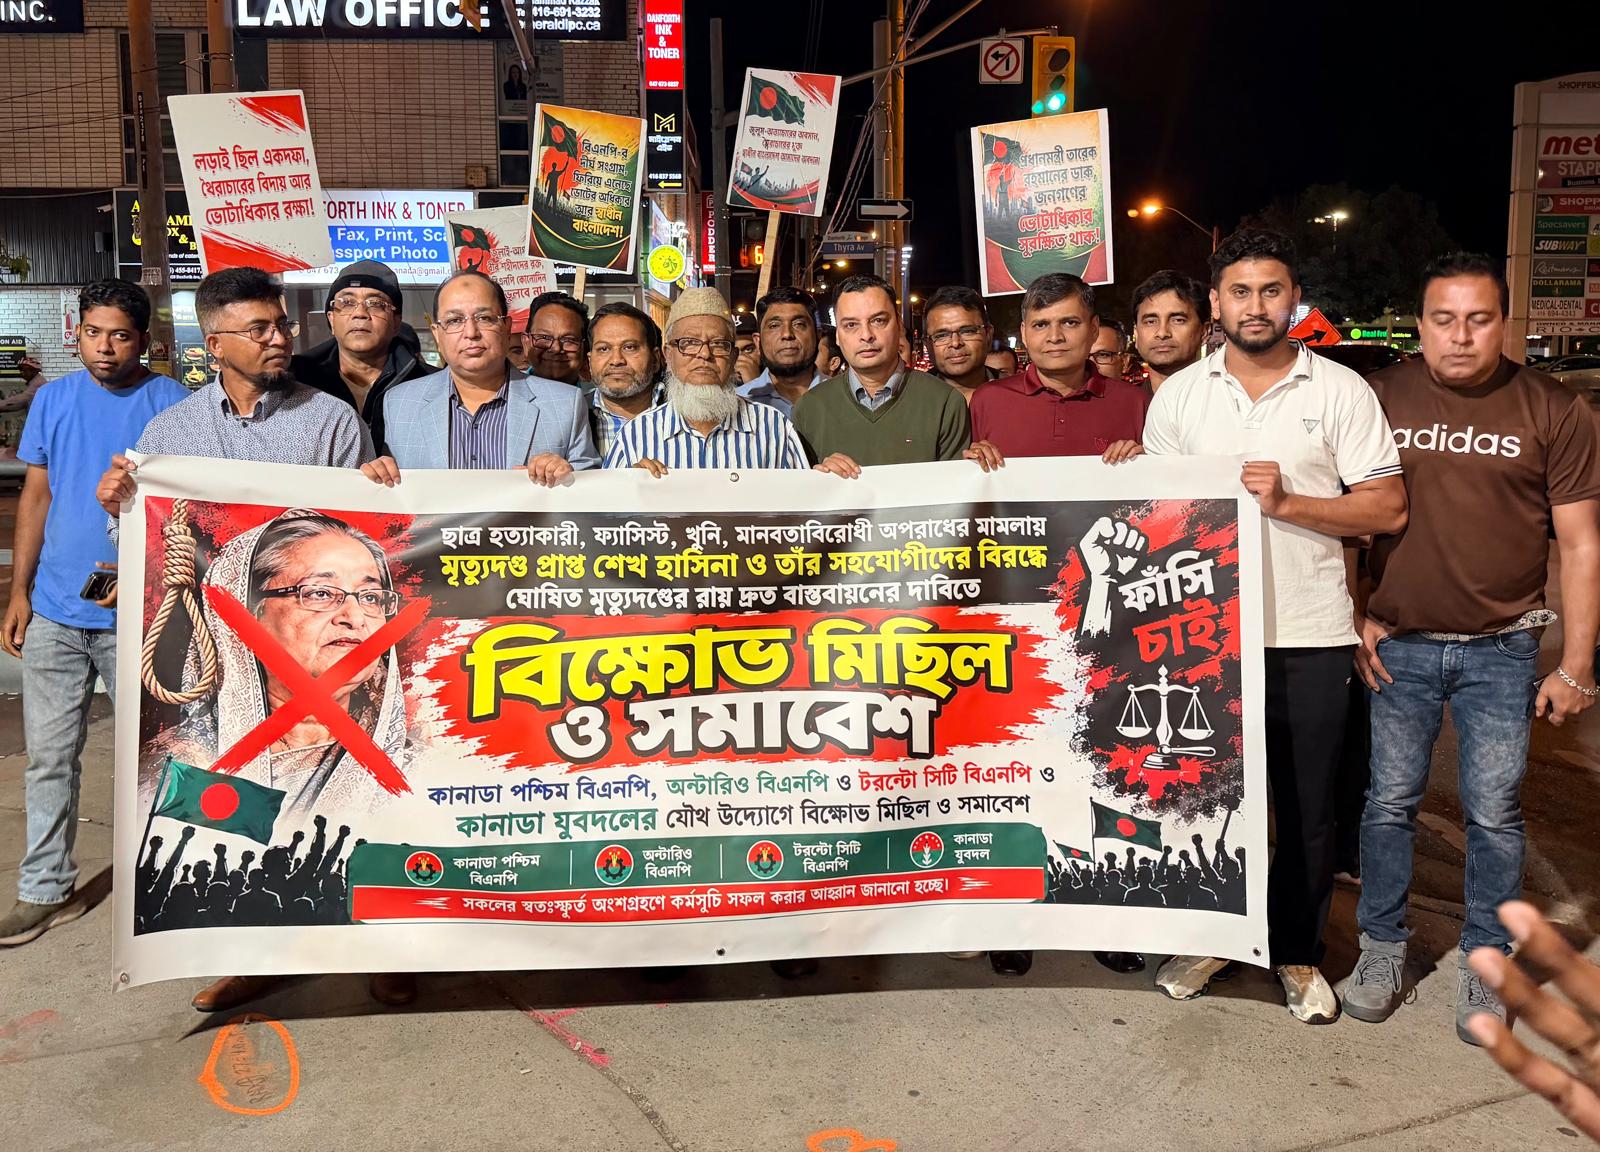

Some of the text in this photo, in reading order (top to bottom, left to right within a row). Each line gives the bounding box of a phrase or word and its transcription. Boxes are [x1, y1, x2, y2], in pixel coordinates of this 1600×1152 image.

[0, 0, 54, 22] INC.
[237, 0, 327, 27] LAW
[647, 13, 680, 23] DANFORTH
[655, 24, 672, 35] INK
[658, 36, 666, 47] &
[648, 48, 680, 59] TONER
[193, 146, 231, 173] লড়াই
[232, 145, 259, 169] ছিল
[1066, 146, 1097, 162] তারেক
[257, 171, 287, 192] বিদায়
[288, 174, 311, 190] আর
[1023, 167, 1068, 187] রহমানের
[598, 190, 632, 207] অধিকার
[1034, 185, 1088, 206] জনগণের
[205, 198, 280, 225] ভোটাধিকার
[323, 201, 366, 219] ORTH
[372, 201, 397, 219] INK
[402, 202, 412, 219] &
[574, 204, 594, 217] আর
[1018, 207, 1093, 232] ভোটাধিকার
[337, 229, 369, 243] Fax,
[374, 228, 417, 243] Print,
[572, 218, 624, 237] বাংলাদেশ!
[833, 243, 855, 253] Thyra
[1535, 240, 1583, 251] SUBWAY
[334, 246, 438, 265] ssport Photo
[1393, 424, 1521, 458] adidas
[441, 516, 1047, 550] ছাত্র হত্যাকারী, ফ্যাসিস্ট, খুনি, মানবতাবিরোধী অপরাধের মামলায়
[536, 552, 586, 579] প্রাপ্ত
[594, 552, 648, 579] শেখ
[655, 548, 739, 582] হাসিনা
[746, 555, 767, 575] ও
[774, 546, 822, 576] তাঁর
[828, 541, 971, 576] সহযোগীদের
[1118, 550, 1215, 613] ফাঁসি
[505, 582, 583, 610] ঘোষিত
[695, 586, 733, 609] রায়
[738, 586, 777, 608] দ্রুত
[782, 581, 902, 608] বাস্তবায়নের
[907, 574, 982, 603] দাবিতে
[1132, 598, 1222, 663] চাই
[464, 620, 1015, 720] বিক্ষোভ মিছিল
[550, 691, 939, 761] ও সমাবেশ
[427, 761, 1055, 806] কানাডা পশ্চিম বিএনপি, অন্টারিও বিএনপি ও টরন্টো সিটি বিএনপি ও
[456, 794, 1031, 840] কানাডা যুবদলের যৌথ উদ্যোগে বিক্ষোভ মিছিল ও সমাবেশ
[953, 832, 993, 845] কানাডা
[642, 845, 693, 862] অন্টারিও
[793, 840, 862, 858] টরন্টো সিটি
[954, 849, 990, 864] যুবদল
[453, 851, 540, 871] কানাডা পশ্চিম
[645, 862, 692, 878] বিএনপি
[803, 856, 848, 873] বিএনপি
[469, 869, 518, 886] বিএনপি
[463, 897, 516, 913] সকলের
[592, 896, 666, 913] অংশগ্রহণে
[727, 892, 765, 907] সফল
[770, 889, 805, 905] করার
[860, 880, 910, 897] জানানো
